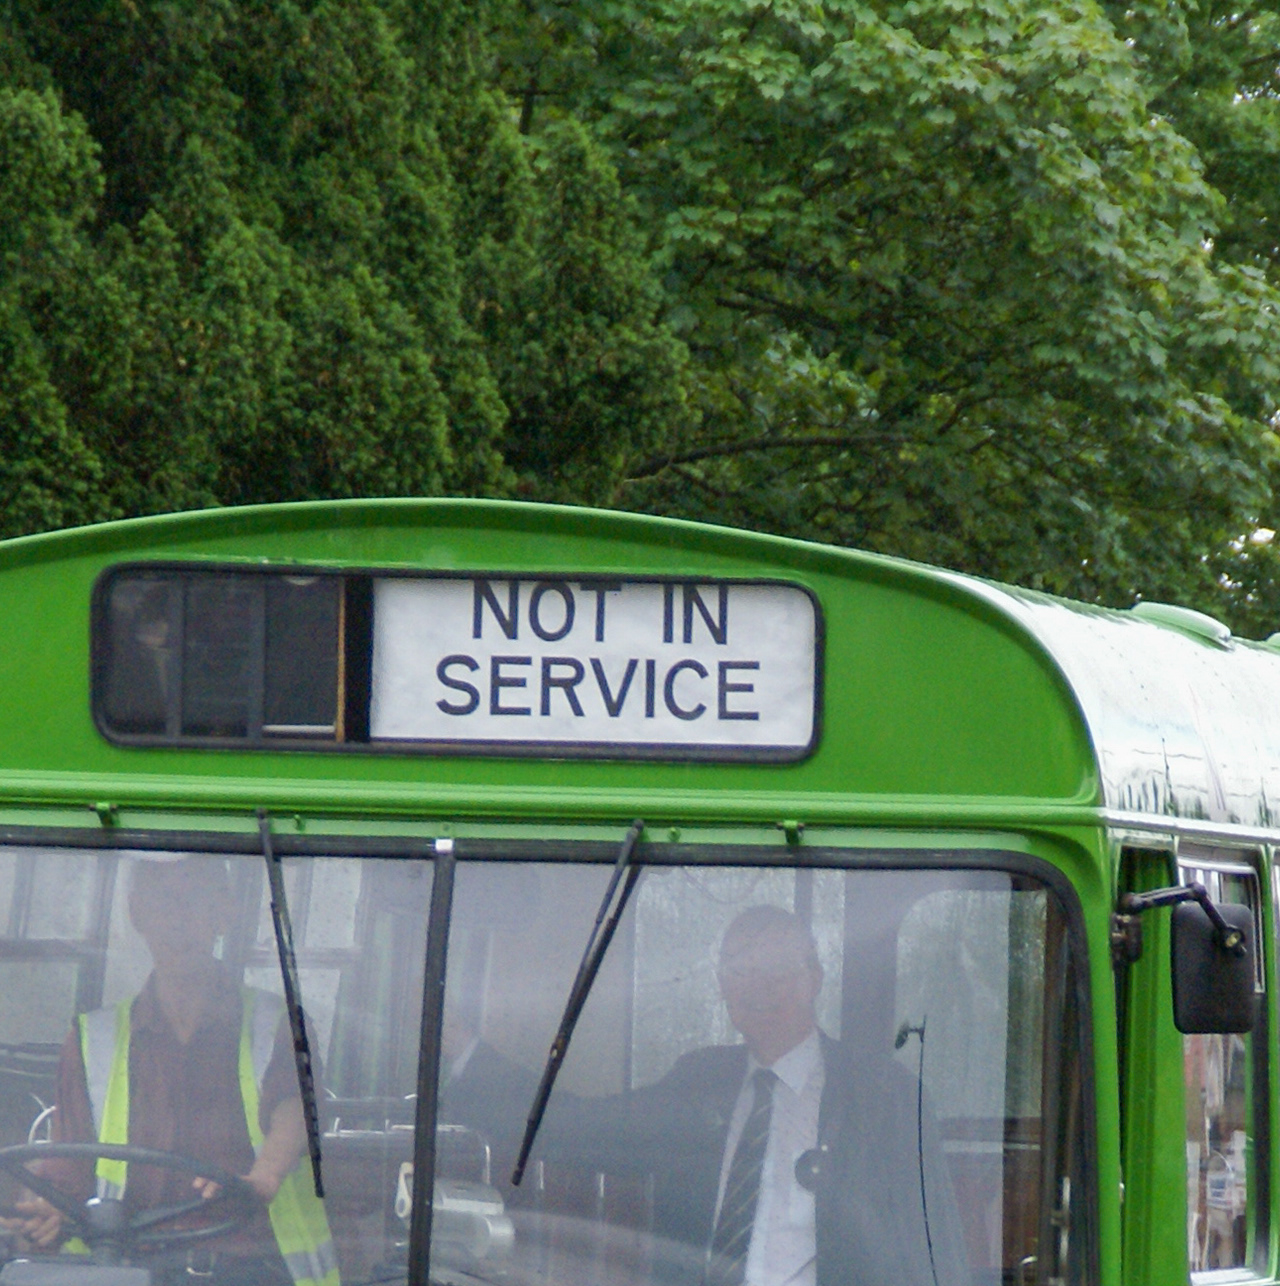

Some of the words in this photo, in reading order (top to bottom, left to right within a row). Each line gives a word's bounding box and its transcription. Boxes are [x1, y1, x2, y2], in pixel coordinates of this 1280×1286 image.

[472, 581, 622, 642] NOT
[662, 583, 729, 645] IN
[435, 655, 760, 721] SERVICE
